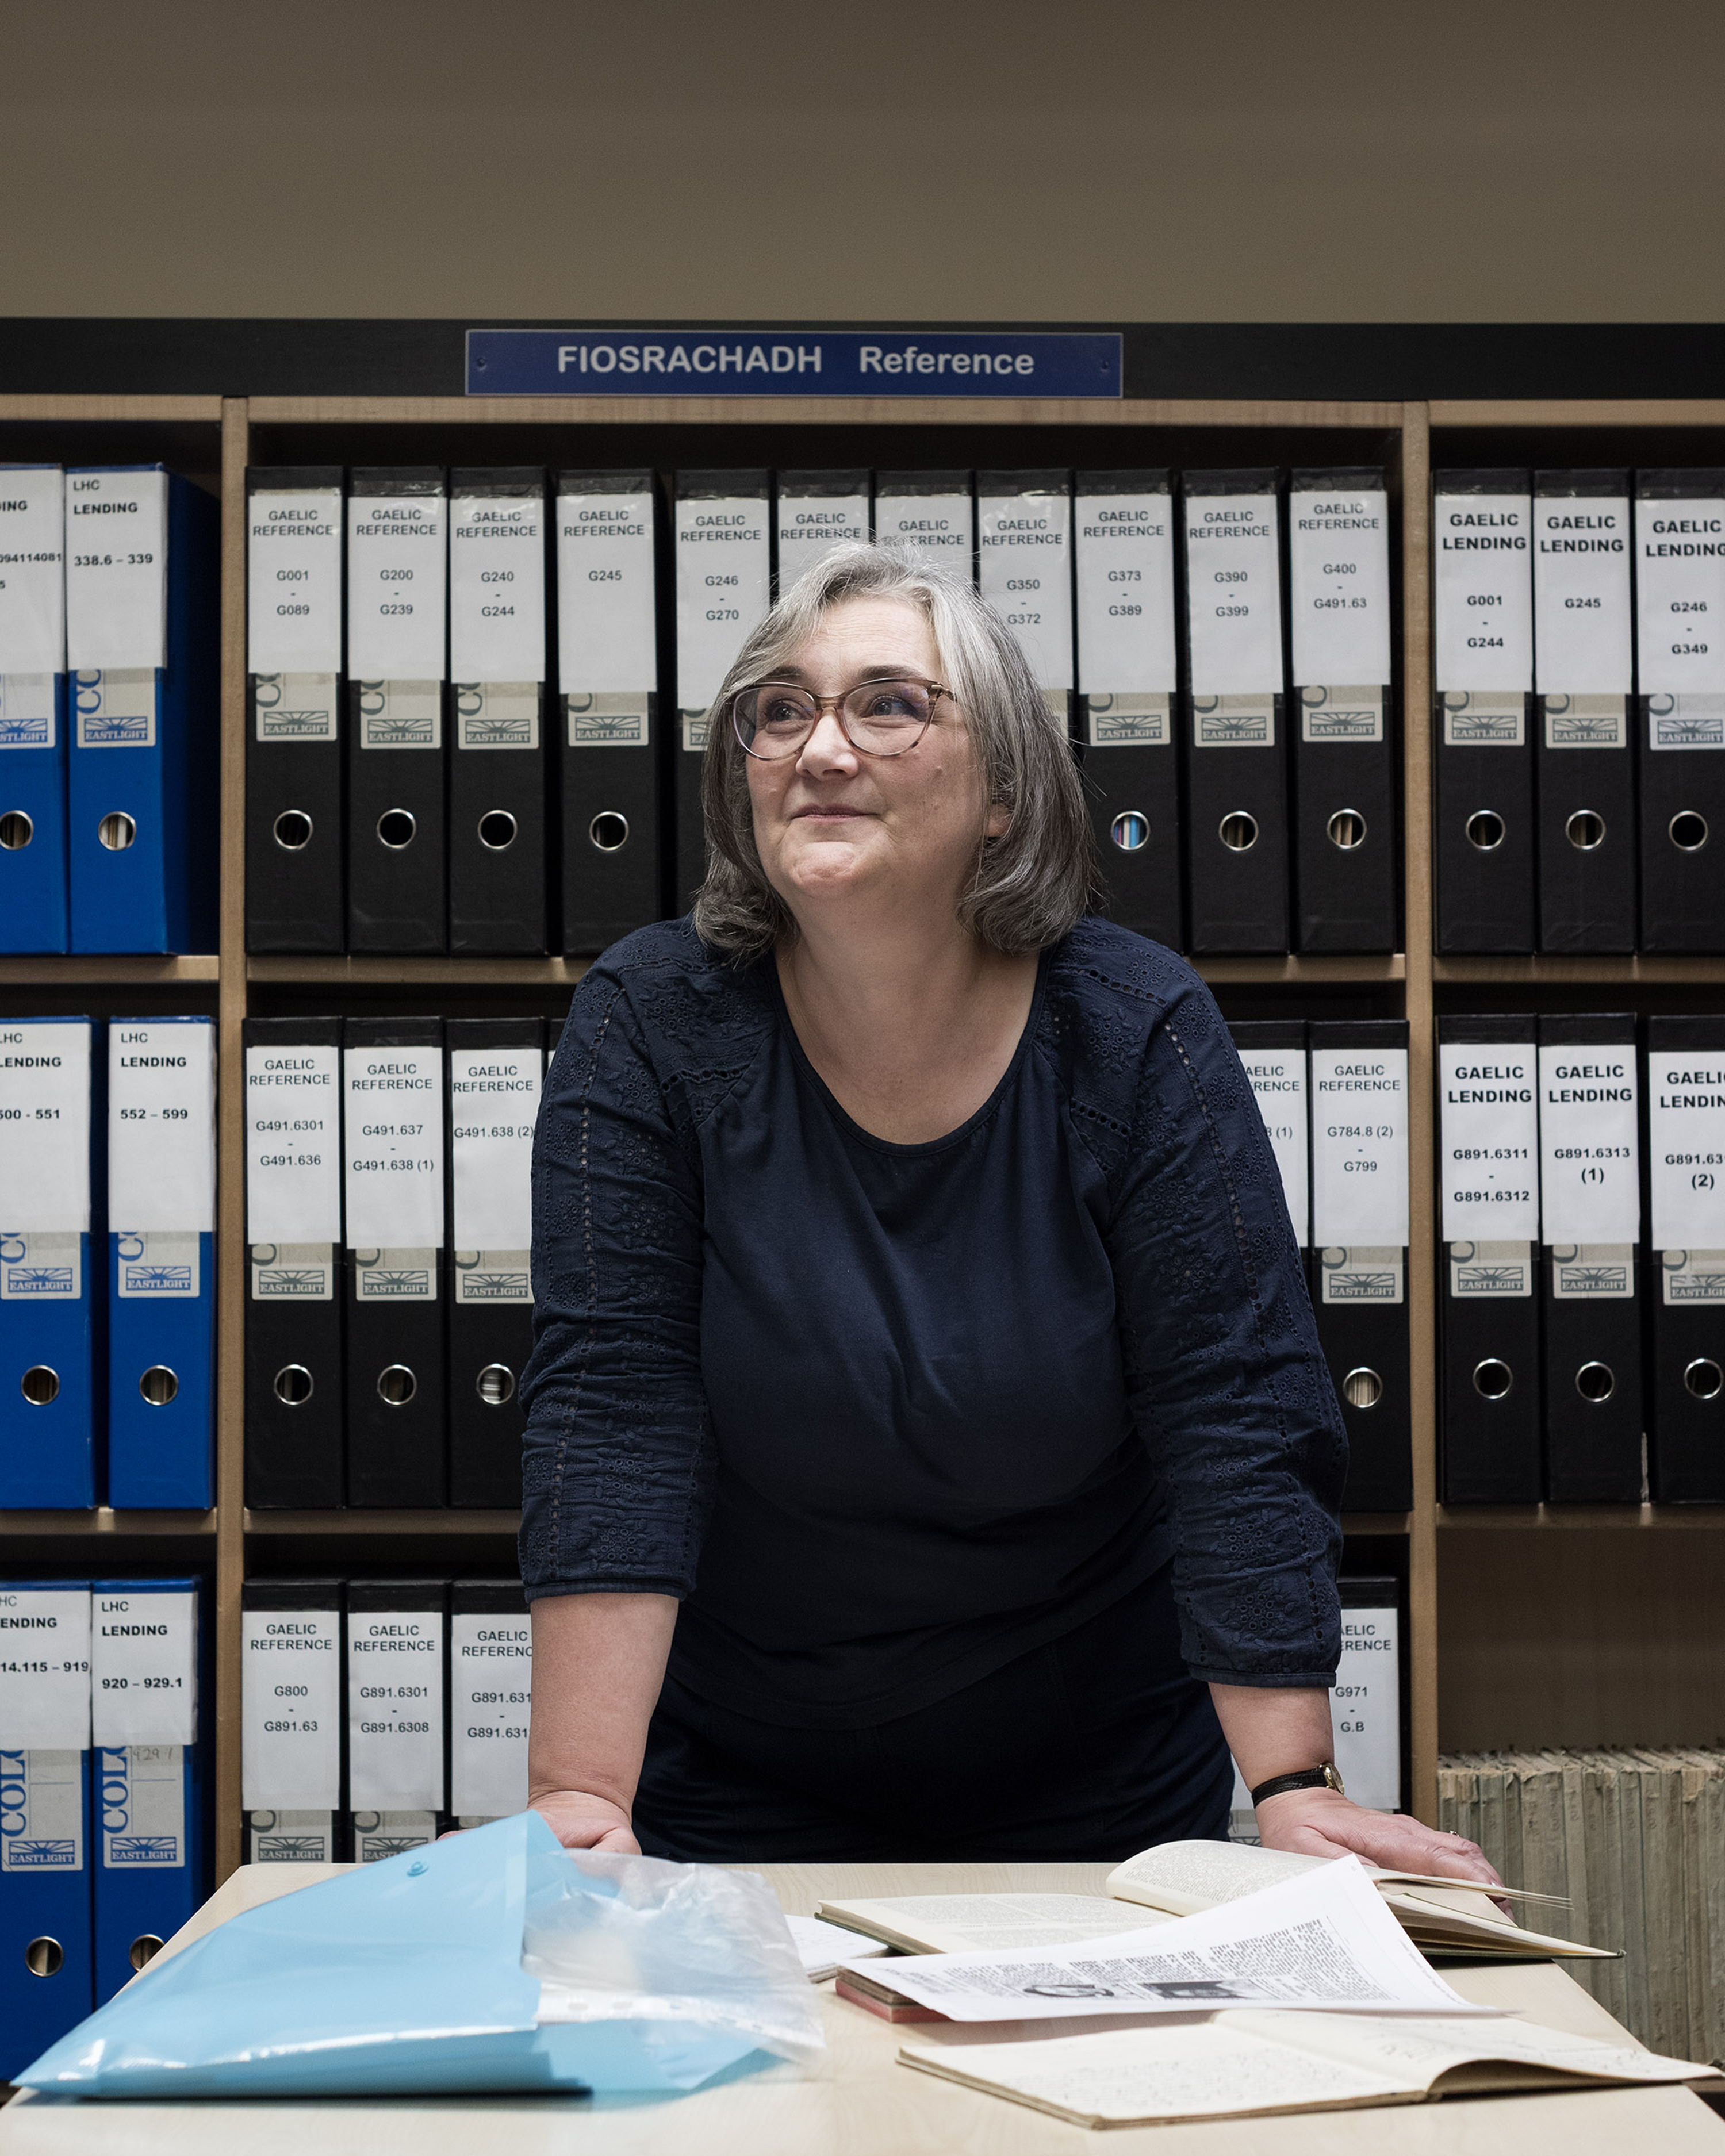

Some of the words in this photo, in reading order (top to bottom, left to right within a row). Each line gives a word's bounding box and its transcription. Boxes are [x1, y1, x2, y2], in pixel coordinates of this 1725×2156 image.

[557, 345, 822, 373] FIOSRACHADH
[859, 346, 1034, 374] Reference
[74, 479, 100, 492] LHC
[0, 500, 28, 512] ING
[74, 502, 138, 515] LENDING
[1314, 504, 1363, 515] GAELIC
[269, 509, 318, 521] GAELIC
[372, 509, 421, 520] GAELIC
[471, 512, 521, 523] GAELIC
[579, 511, 629, 521] GAELIC
[796, 513, 845, 524] GAELIC
[1099, 511, 1148, 522] GAELIC
[1205, 511, 1254, 523] GAELIC
[1450, 513, 1519, 527] GAELIC
[696, 515, 745, 527] GAELIC
[899, 520, 949, 531] GAELIC
[998, 519, 1047, 531] GAELIC
[1299, 518, 1379, 530] REFERENCE
[1547, 515, 1616, 530] GAELIC
[1653, 519, 1722, 534] GAELIC
[253, 524, 332, 536] REFERENCE
[356, 524, 436, 535] REFERENCE
[457, 525, 536, 538] REFERENCE
[565, 524, 644, 536] REFERENCE
[781, 528, 861, 539] REFERENCE
[1084, 525, 1164, 538] REFERENCE
[1190, 525, 1270, 538] REFERENCE
[681, 530, 761, 542] REFERENCE
[983, 534, 1062, 546] REFERENCE
[1443, 536, 1527, 550] LENDING
[1540, 539, 1624, 553] LENDING
[1646, 542, 1725, 558] LENDING
[75, 554, 112, 566] 338.6
[128, 553, 154, 565] 339
[1323, 563, 1357, 574] G400
[277, 570, 308, 581] G001
[380, 569, 413, 581] G200
[481, 571, 515, 583] G240
[589, 570, 622, 581] G245
[705, 575, 739, 586] G246
[1108, 570, 1141, 582] G373
[1214, 571, 1248, 583] G390
[1007, 579, 1040, 591] G350
[1314, 597, 1367, 609] G491.63
[1467, 595, 1502, 607] G001
[1565, 597, 1601, 609] G245
[1671, 601, 1708, 613] G246
[277, 604, 310, 616] G089
[380, 604, 413, 615] G239
[482, 606, 515, 617] G244
[706, 609, 739, 621] G270
[1109, 605, 1142, 616] G389
[1216, 605, 1249, 617] G399
[1008, 613, 1041, 624] G372
[1467, 637, 1504, 649] G244
[1672, 643, 1708, 655] G349
[264, 723, 329, 735] EASTLIGHT
[576, 728, 640, 740] EASTLIGHT
[1098, 728, 1162, 739] EASTLIGHT
[1202, 730, 1266, 740] EASTLIGHT
[1310, 726, 1375, 735] EASTLIGHT
[1452, 728, 1517, 739] EASTLIGHT
[86, 730, 147, 741] EASTLIGHT
[368, 731, 433, 743] EASTLIGHT
[466, 732, 530, 743] EASTLIGHT
[1554, 731, 1617, 741] EASTLIGHT
[1658, 732, 1723, 743] EASTLIGHT
[121, 1032, 148, 1044] LHC
[121, 1056, 187, 1068] LENDING
[265, 1058, 315, 1071] GAELIC
[367, 1063, 417, 1075] GAELIC
[469, 1065, 518, 1077] GAELIC
[1245, 1065, 1285, 1076] AELIC
[1335, 1064, 1385, 1076] GAELIC
[1455, 1065, 1524, 1080] GAELIC
[1555, 1064, 1624, 1079] GAELIC
[250, 1073, 331, 1086] REFERENCE
[1667, 1071, 1725, 1085] GAELI
[352, 1079, 432, 1091] REFERENCE
[454, 1080, 534, 1092] REFERENCE
[1254, 1080, 1300, 1092] RENCE
[1320, 1080, 1400, 1091] REFERENCE
[1448, 1089, 1532, 1103] LENDING
[1549, 1088, 1632, 1103] LENDING
[36, 1108, 60, 1120] 551
[121, 1108, 146, 1119] 552
[163, 1108, 188, 1120] 599
[256, 1119, 323, 1131] G491.6301
[363, 1124, 423, 1136] G491.637
[454, 1126, 514, 1138] G491.638
[518, 1126, 534, 1139] (2)
[1276, 1127, 1293, 1140] (1)
[1328, 1126, 1373, 1137] G784.8
[1377, 1126, 1393, 1138] (2)
[1453, 1148, 1528, 1160] G891.6311
[1554, 1147, 1630, 1160] G891.6313
[1665, 1153, 1725, 1165] G891.63
[260, 1154, 321, 1167] G491.636
[352, 1160, 414, 1172] G491.638
[417, 1159, 434, 1172] (1)
[1344, 1161, 1378, 1172] G799
[1581, 1167, 1605, 1185] (1)
[1692, 1173, 1715, 1191] (2)
[1454, 1190, 1530, 1202] G891.6312
[9, 1280, 73, 1291] EASTLIGHT
[126, 1279, 190, 1290] EASTLIGHT
[259, 1283, 324, 1294] EASTLIGHT
[363, 1283, 428, 1294] EASTLIGHT
[1459, 1280, 1523, 1290] EASTLIGHT
[1562, 1281, 1626, 1291] EASTLIGHT
[463, 1286, 528, 1297] EASTLIGHT
[1330, 1287, 1395, 1297] EASTLIGHT
[102, 1601, 129, 1612] LHC
[102, 1625, 168, 1637] LENDING
[266, 1624, 317, 1635] GAELIC
[370, 1625, 419, 1637] GAELIC
[1341, 1624, 1375, 1636] ELIC
[478, 1630, 528, 1642] GAELIC
[251, 1639, 332, 1651] REFERENCE
[354, 1640, 435, 1652] REFERENCE
[462, 1645, 532, 1657] REFERENC
[102, 1678, 129, 1690] 920
[144, 1677, 182, 1689] 929.1
[275, 1685, 308, 1697] G800
[360, 1686, 427, 1698] G891.6301
[1335, 1686, 1367, 1698] G971
[264, 1720, 318, 1732] G891.63
[361, 1721, 430, 1733] G891.6308
[1341, 1721, 1365, 1733] G.B
[467, 1727, 528, 1739] G891.631
[10, 1853, 75, 1865] EASTLIGHT
[112, 1850, 177, 1861] EASTLIGHT
[259, 1850, 324, 1860] EASTLIGHT
